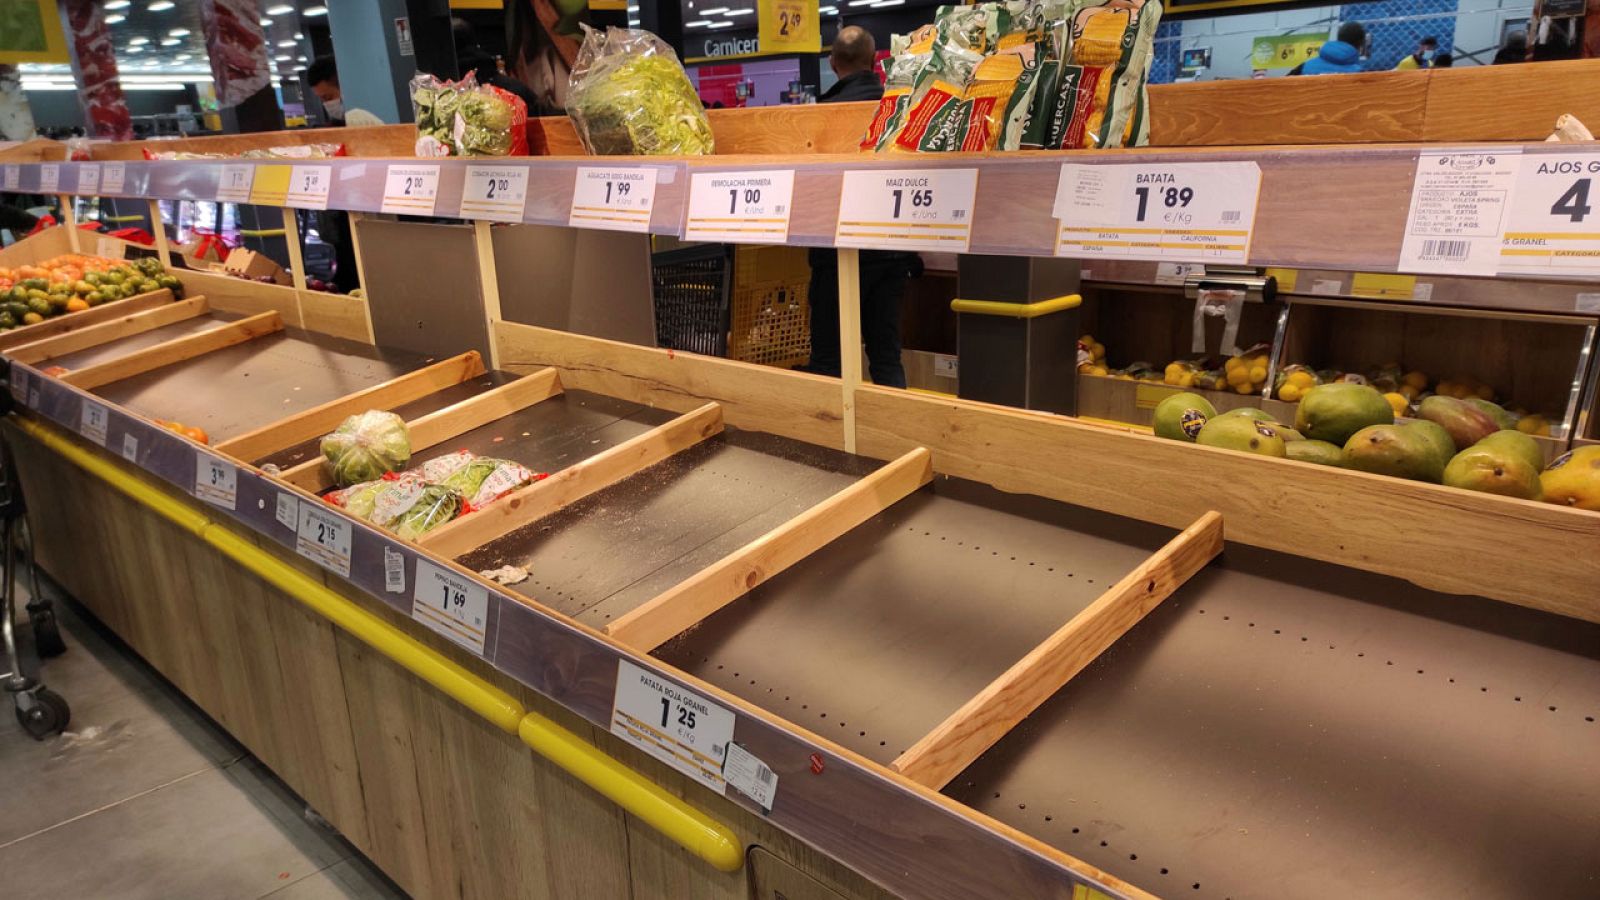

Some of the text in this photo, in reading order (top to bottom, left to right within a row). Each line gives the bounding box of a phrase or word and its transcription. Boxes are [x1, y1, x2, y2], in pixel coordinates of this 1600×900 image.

[779, 11, 789, 35] 2
[1136, 173, 1176, 184] BATATA
[1536, 162, 1583, 175] AJOS
[404, 177, 413, 195] 2
[486, 179, 496, 199] 2
[605, 181, 612, 204] 1
[711, 178, 771, 188] REMOLACHA PRIMERA
[904, 178, 929, 187] DULCE
[729, 189, 738, 215] 1
[893, 189, 933, 219] 1 '65
[1135, 187, 1150, 222] 1
[1160, 186, 1194, 208] '89
[1550, 178, 1592, 223] 4
[211, 468, 217, 485] 3
[317, 523, 325, 544] 2
[443, 585, 449, 609] 1
[640, 675, 709, 716] PATATA ROJA GRANEL
[661, 697, 696, 730] 1 '25
